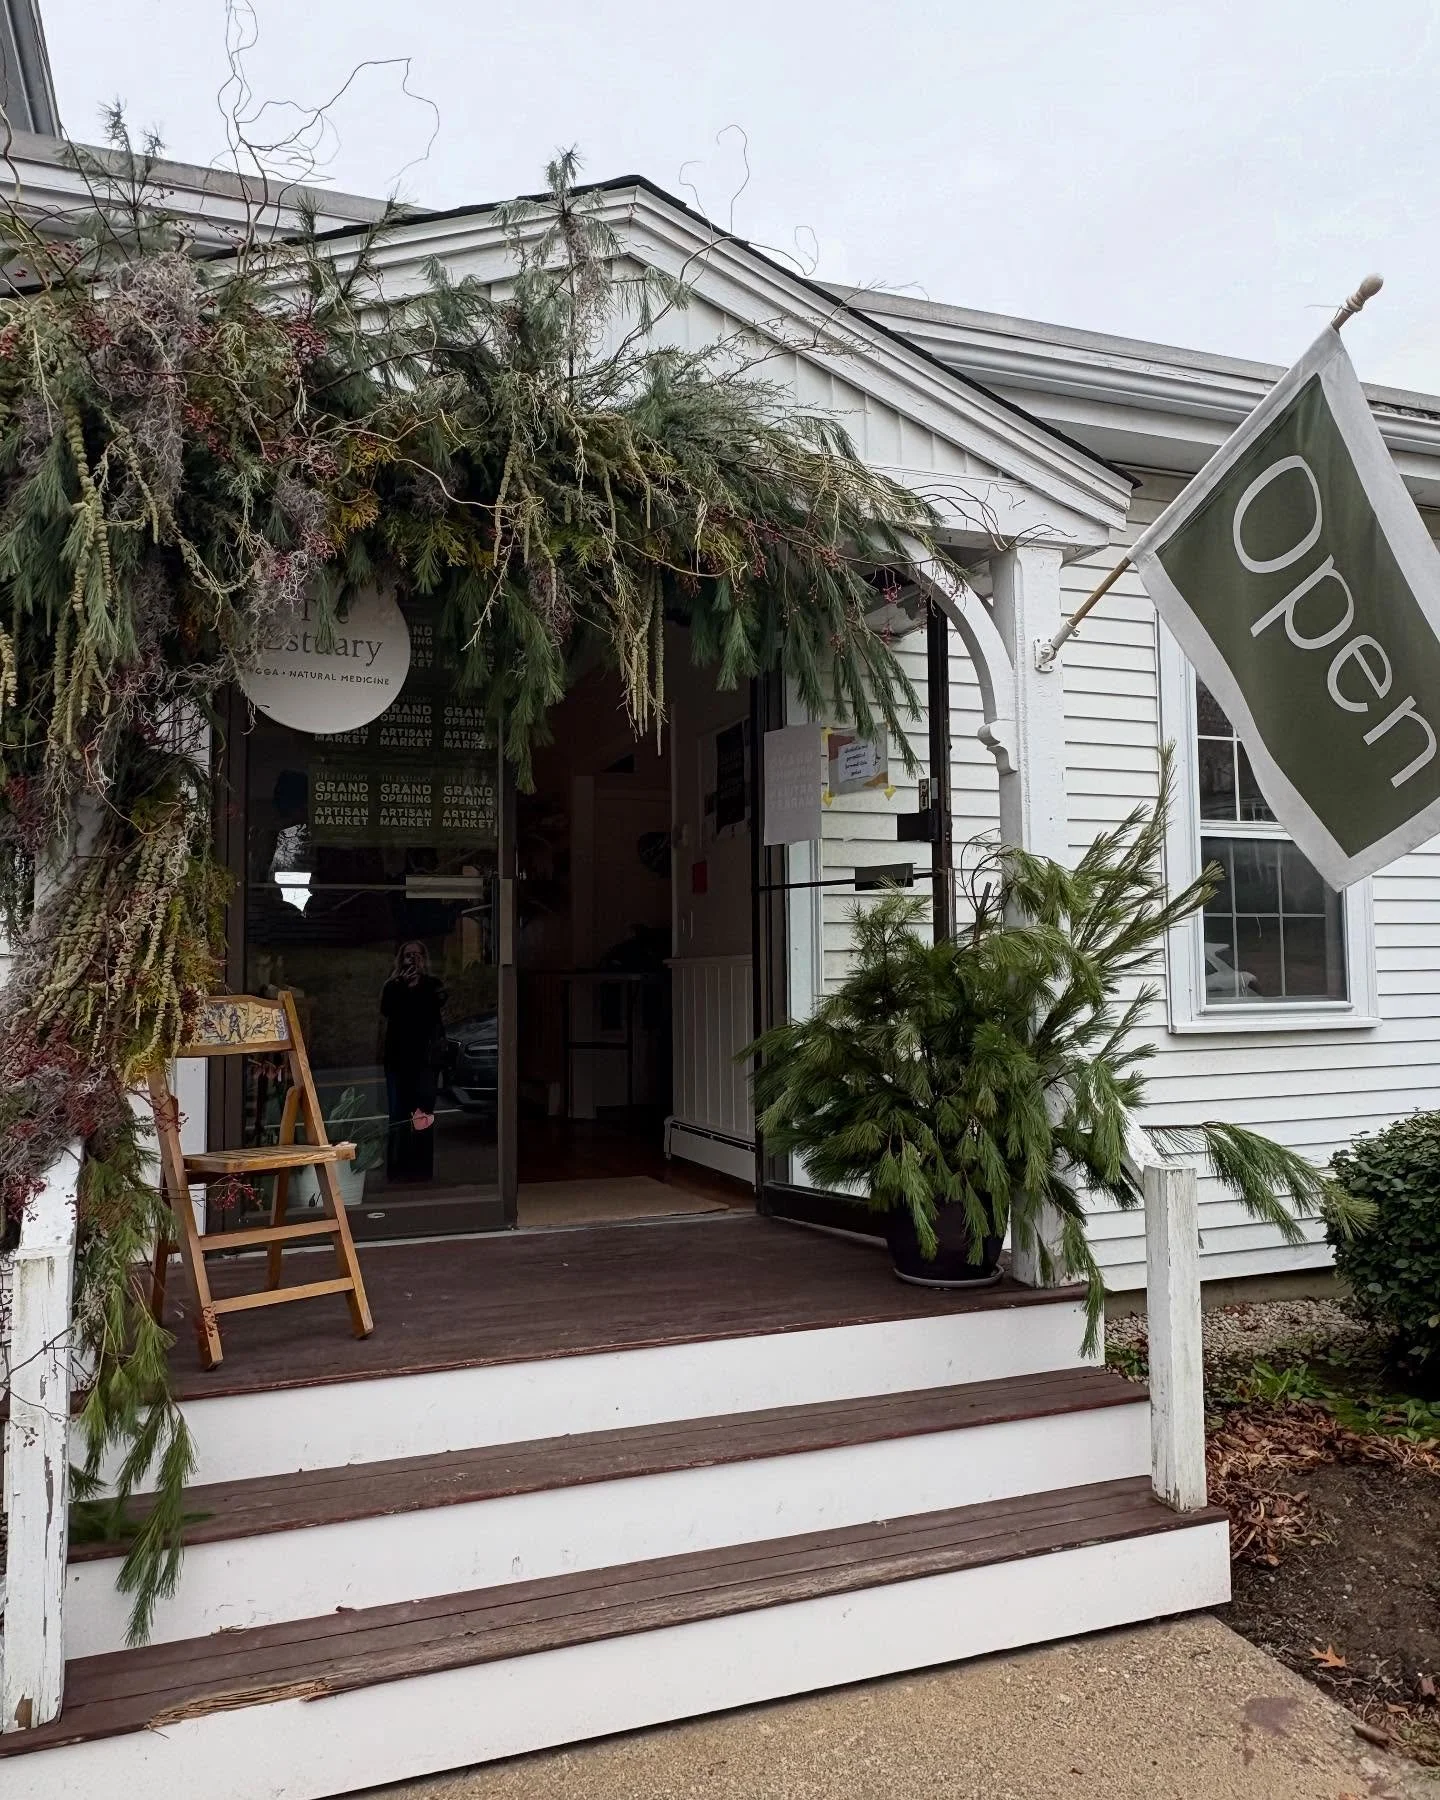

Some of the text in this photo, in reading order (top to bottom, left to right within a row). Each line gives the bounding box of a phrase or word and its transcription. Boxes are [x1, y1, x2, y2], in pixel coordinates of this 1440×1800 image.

[300, 598, 350, 625] Te
[1232, 455, 1438, 789] Open
[252, 667, 390, 686] OGA NATURAL MEDICINE
[444, 706, 485, 718] GRAN
[444, 717, 486, 727] OPENIN
[380, 728, 432, 738] ARTISAN
[314, 734, 369, 745] MARKET
[379, 737, 432, 747] MARKET
[314, 781, 369, 793] GRAND
[379, 783, 432, 794] GRAND
[442, 786, 494, 797] GRAND
[314, 792, 369, 802] OPENING
[379, 794, 432, 804] OPENING
[442, 796, 494, 806] OPENING
[314, 806, 369, 816] ARTISAN
[379, 808, 432, 818] ARTISAN
[442, 809, 494, 819] ARTISAN
[313, 816, 369, 826] MARKET
[379, 817, 432, 828] MARKET
[441, 818, 494, 829] MARKET
